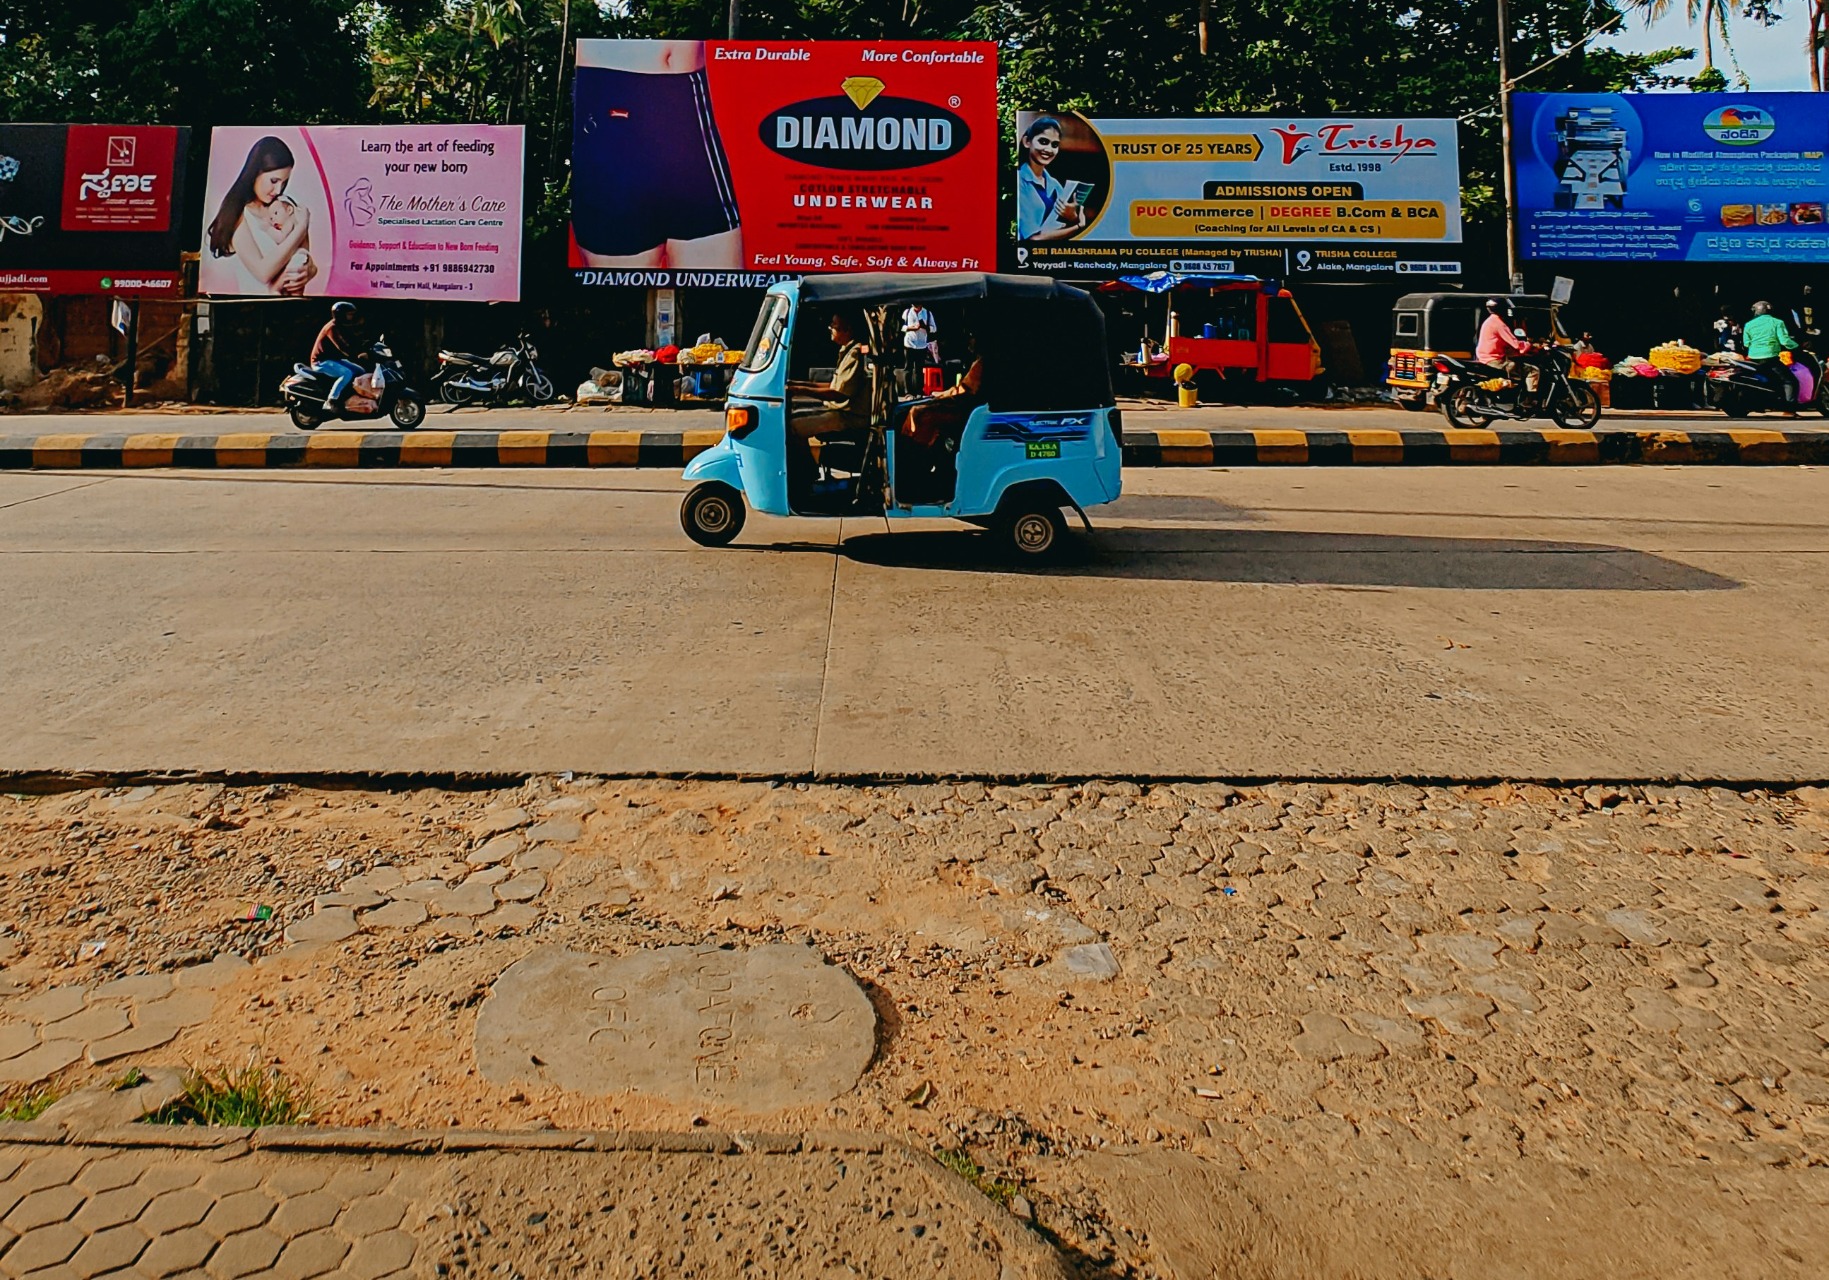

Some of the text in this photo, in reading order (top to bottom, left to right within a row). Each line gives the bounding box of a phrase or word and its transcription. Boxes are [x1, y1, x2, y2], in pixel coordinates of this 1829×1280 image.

[714, 48, 811, 61] Extra Durable
[861, 49, 984, 64] More Confortable
[776, 116, 952, 151] DIAMOND
[1720, 129, 1759, 139] ನಂದಿನಿ
[361, 140, 495, 156] Learn the art of feeding
[1113, 143, 1252, 155] TRUST OF 25 YEARS
[1317, 124, 1437, 164] Trisha
[385, 160, 468, 176] your new born
[1329, 163, 1381, 172] Estd. 1998
[80, 168, 157, 201] ಸ್ವರ್ಣ
[1215, 186, 1352, 197] ADMISSIONS OPEN
[379, 195, 506, 212] The Mother's Care
[793, 195, 933, 209] UNDERWEAR
[1136, 206, 1439, 218] PUC Commerce DEGREE B.Com & BCA
[377, 217, 420, 226] Specialised
[421, 218, 456, 226] Lactation
[478, 219, 503, 227] Centre
[1195, 224, 1247, 234] (Coaching
[1249, 224, 1263, 233] for
[1267, 224, 1279, 233] All
[1283, 225, 1316, 233] Levels
[1319, 225, 1329, 233] of
[1331, 225, 1346, 233] CA
[1349, 225, 1356, 233] &
[1360, 225, 1374, 233] CS
[378, 241, 401, 251] Support
[445, 242, 458, 251] New
[1785, 237, 1829, 249] ಸಹಕಾ
[1119, 248, 1133, 256] PU
[1135, 248, 1179, 256] COLLEGE
[1182, 248, 1228, 258] (Managed
[1230, 249, 1241, 258] by
[1244, 249, 1282, 258] TRISHA)
[1315, 250, 1397, 259] TRISHA COLLEGE
[350, 262, 363, 271] For
[365, 262, 420, 273] Appointments
[422, 263, 439, 272] +91
[754, 255, 979, 270] Feel Young, Safe, Soft & Always Fit
[1120, 261, 1167, 270] Mangalore
[1345, 263, 1394, 272] Mangalore
